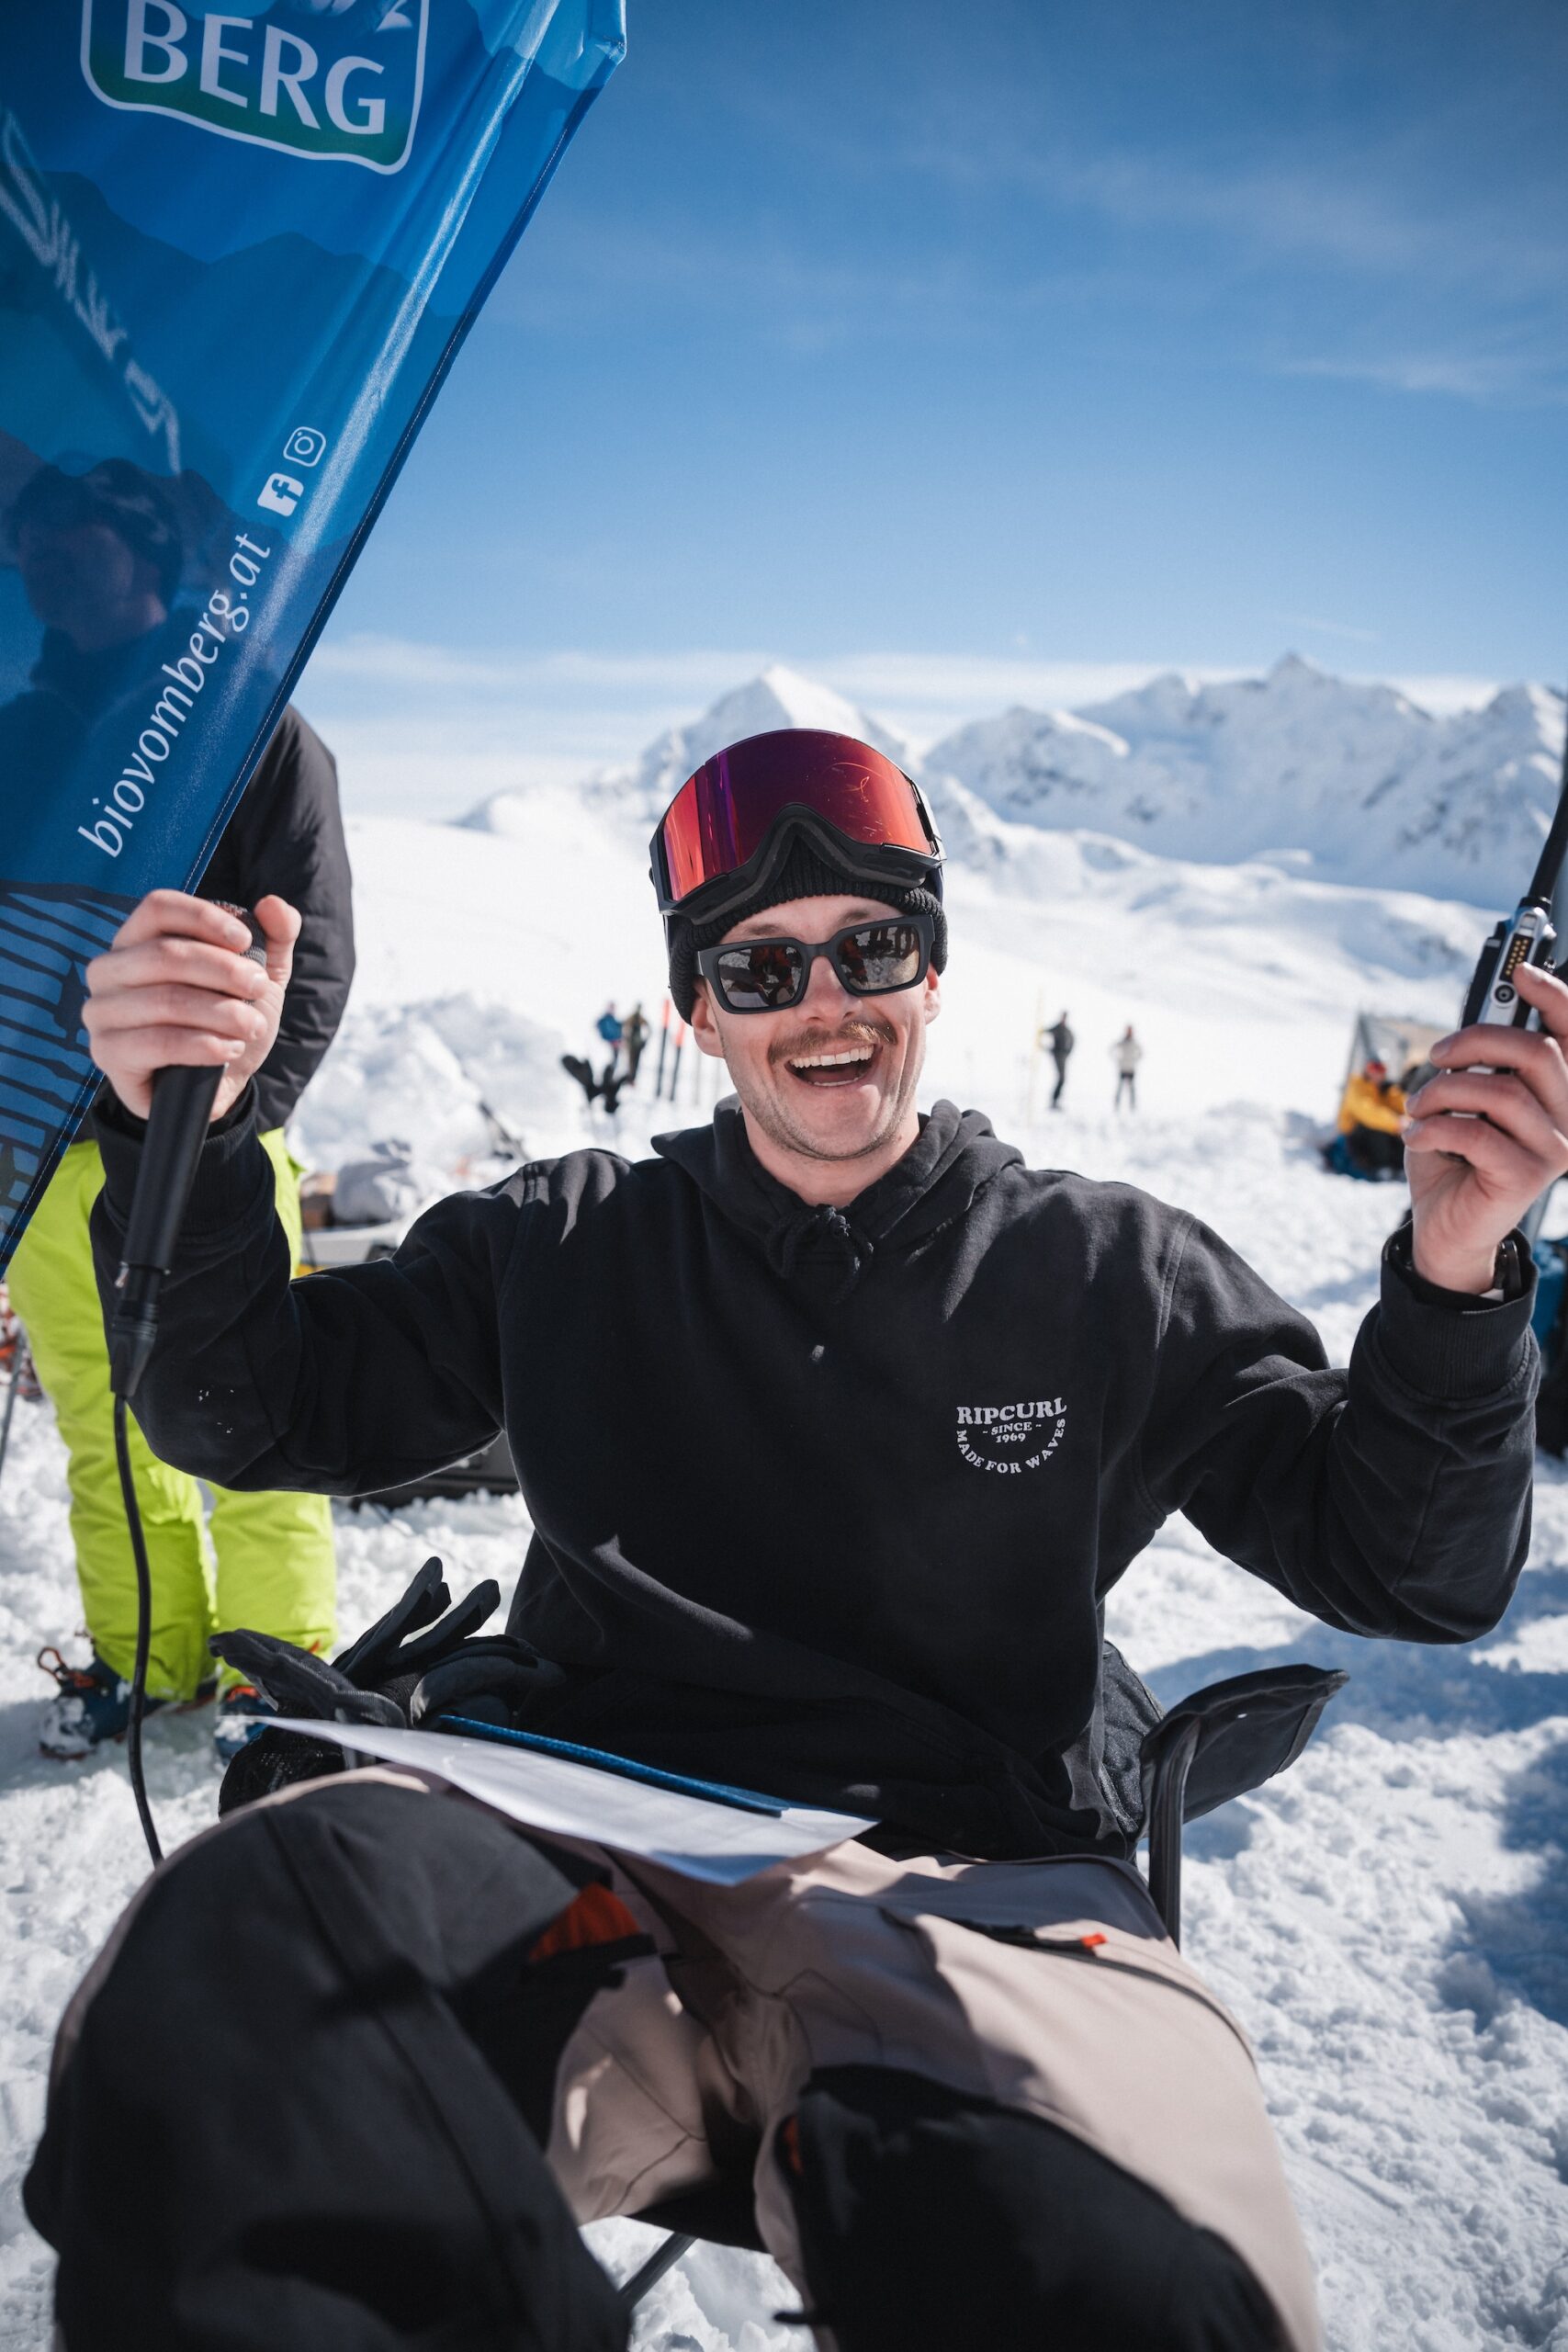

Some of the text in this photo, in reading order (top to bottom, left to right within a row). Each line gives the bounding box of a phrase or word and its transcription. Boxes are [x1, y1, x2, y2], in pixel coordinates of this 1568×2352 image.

[124, 0, 386, 134] BERG
[77, 532, 270, 858] biovomberg.at
[956, 1396, 1067, 1425] RIPCURL
[990, 1421, 1032, 1436] SINCE
[956, 1418, 1066, 1474] MADE FOR WAVES
[995, 1432, 1026, 1443] 1969
